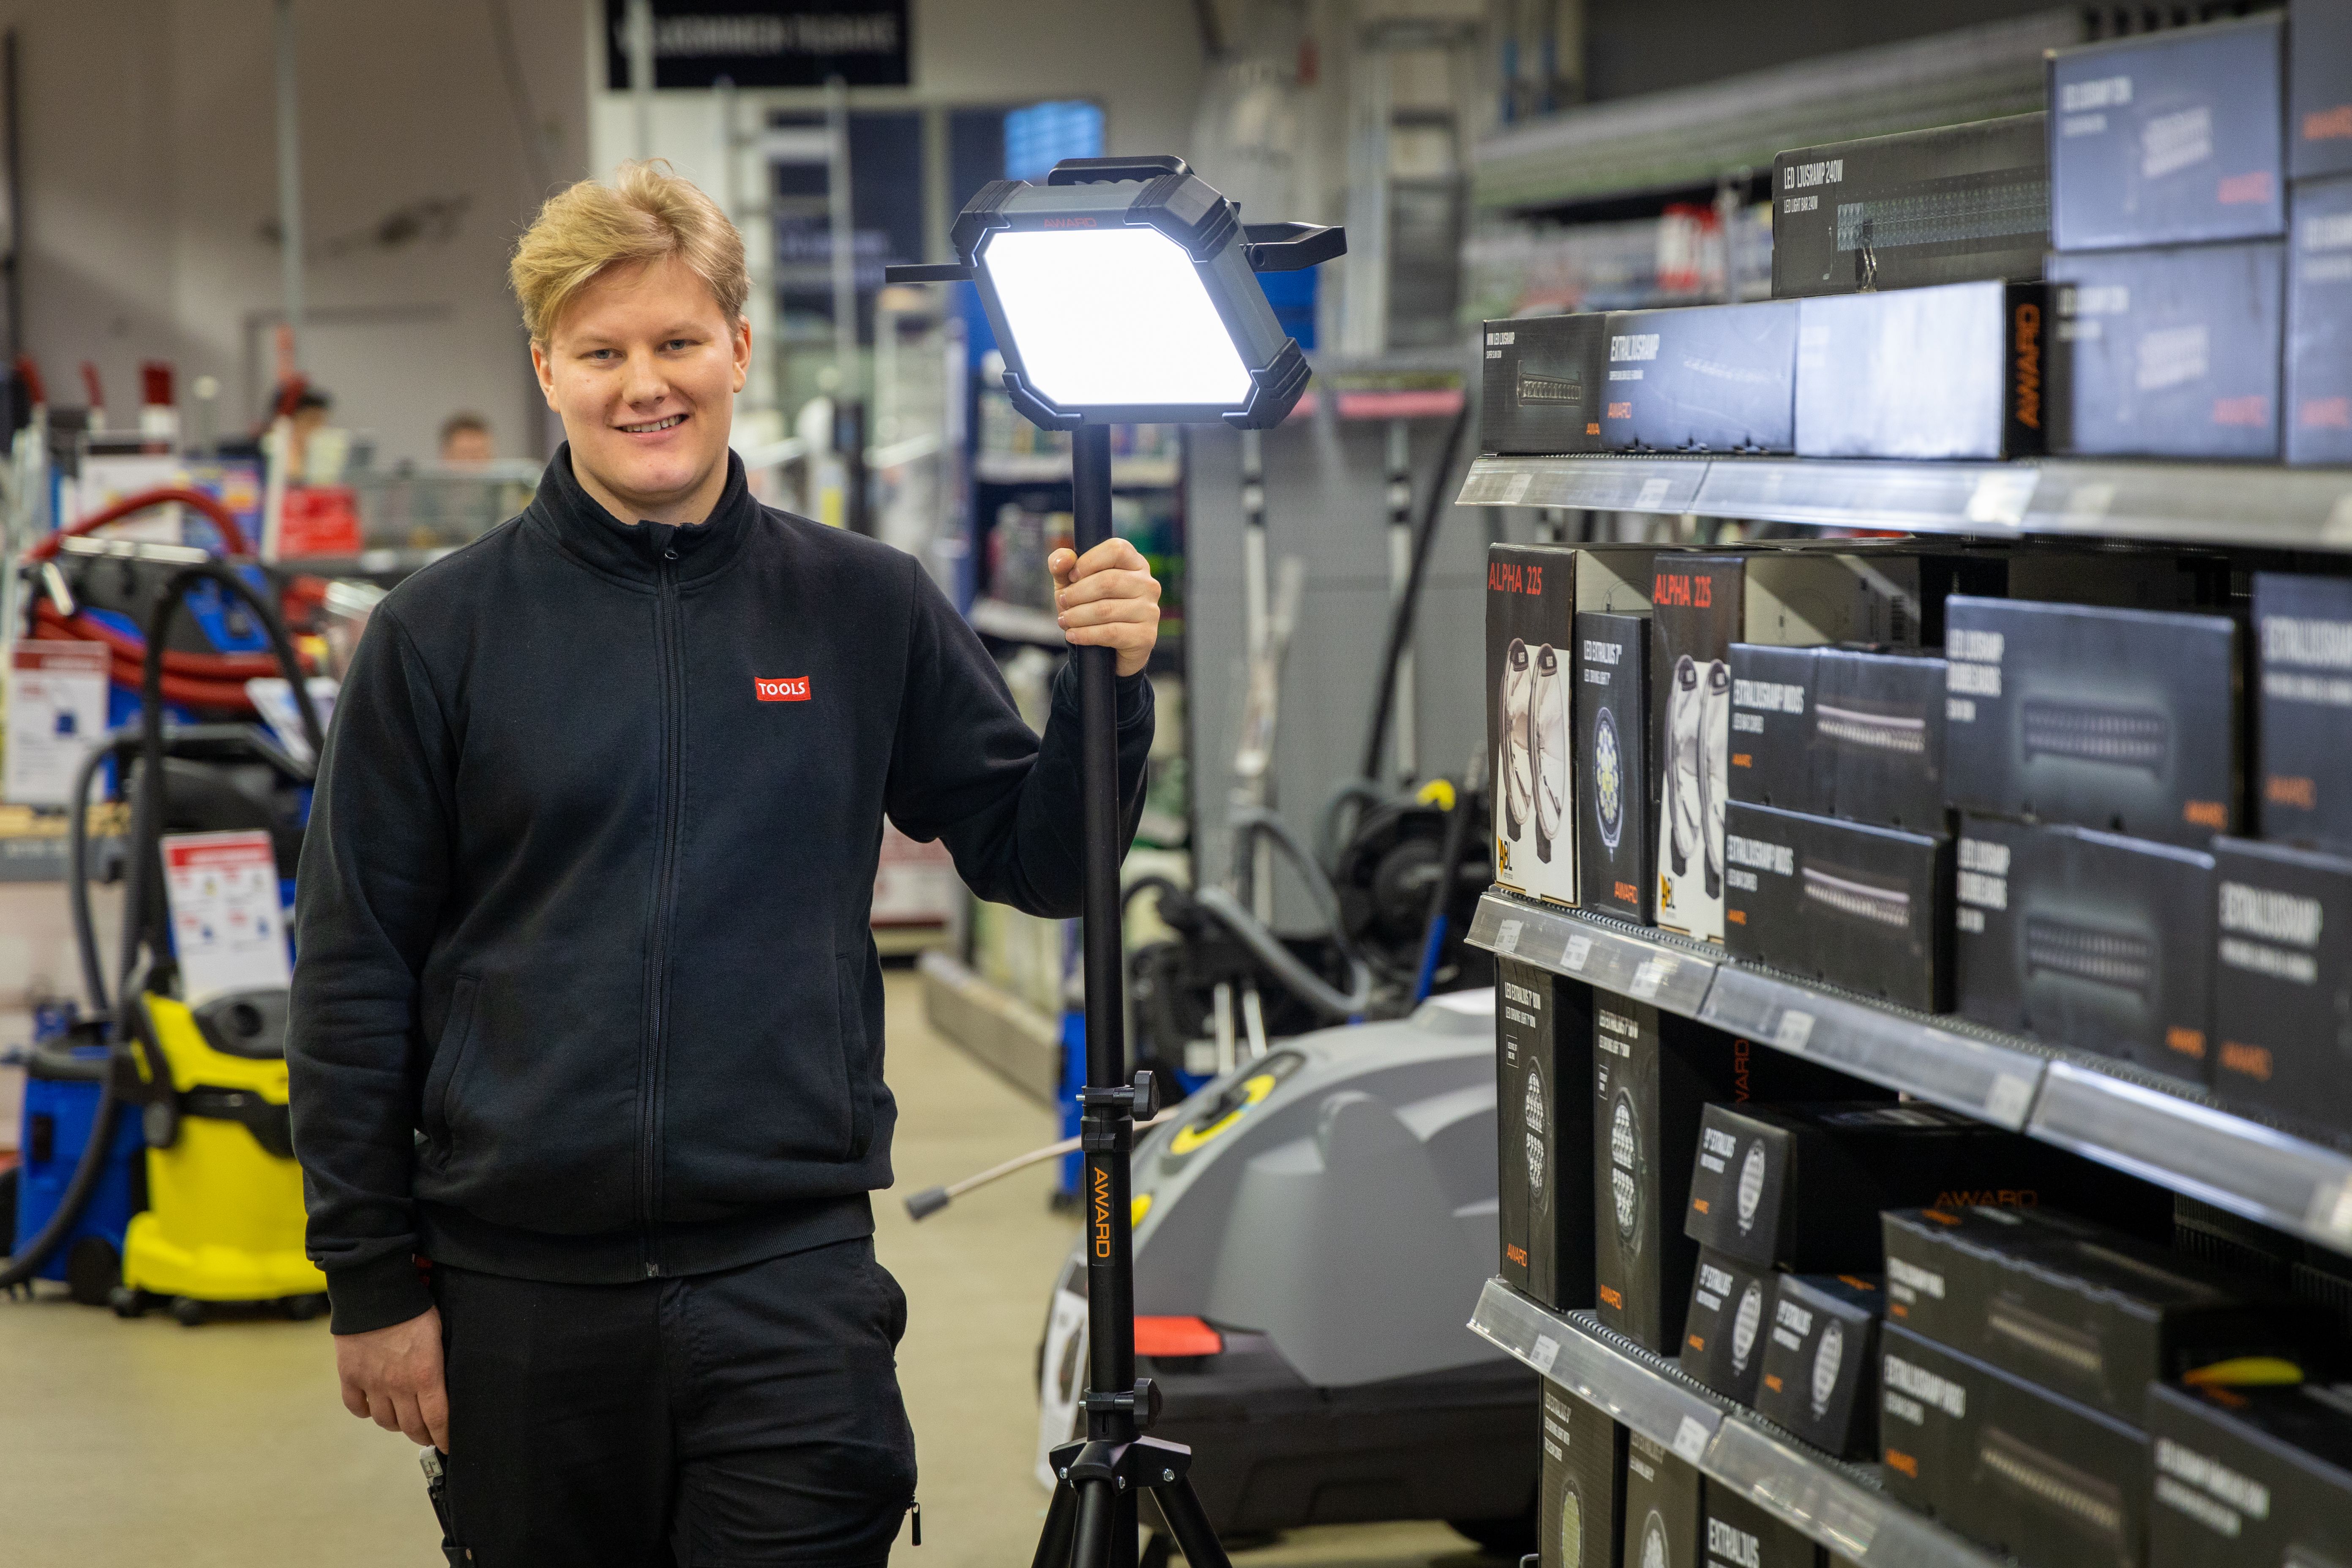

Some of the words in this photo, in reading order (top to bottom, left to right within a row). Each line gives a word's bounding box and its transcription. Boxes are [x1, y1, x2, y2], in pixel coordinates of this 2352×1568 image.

[1784, 166, 1795, 189] LED
[1797, 162, 1825, 188] LJUSRAMP
[1826, 159, 1843, 184] 240W
[1791, 197, 1801, 213] LIGHT
[1808, 195, 1818, 210] 240W
[1044, 218, 1097, 229] AWARD
[2015, 303, 2041, 429] AWARD
[1607, 402, 1632, 419] AWARD
[1488, 562, 1523, 593] ALPHA
[1526, 565, 1542, 595] 225
[1654, 574, 1691, 607] ALPHA
[1694, 575, 1712, 608] 225
[1583, 640, 1592, 661] LED
[1592, 641, 1615, 665] EXTRALJUS
[758, 682, 805, 695] TOOLS
[1499, 840, 1512, 871] ABL
[1614, 881, 1638, 905] AWARD
[1662, 876, 1676, 909] ABL
[1512, 984, 1529, 1006] EXTRALJUS
[1935, 1189, 2038, 1210] AWARD
[1094, 1167, 1110, 1258] AWARD
[1506, 1243, 1528, 1268] AWARD
[1600, 1284, 1622, 1310] AWARD
[1708, 1516, 1760, 1568] EXTRALJUS
